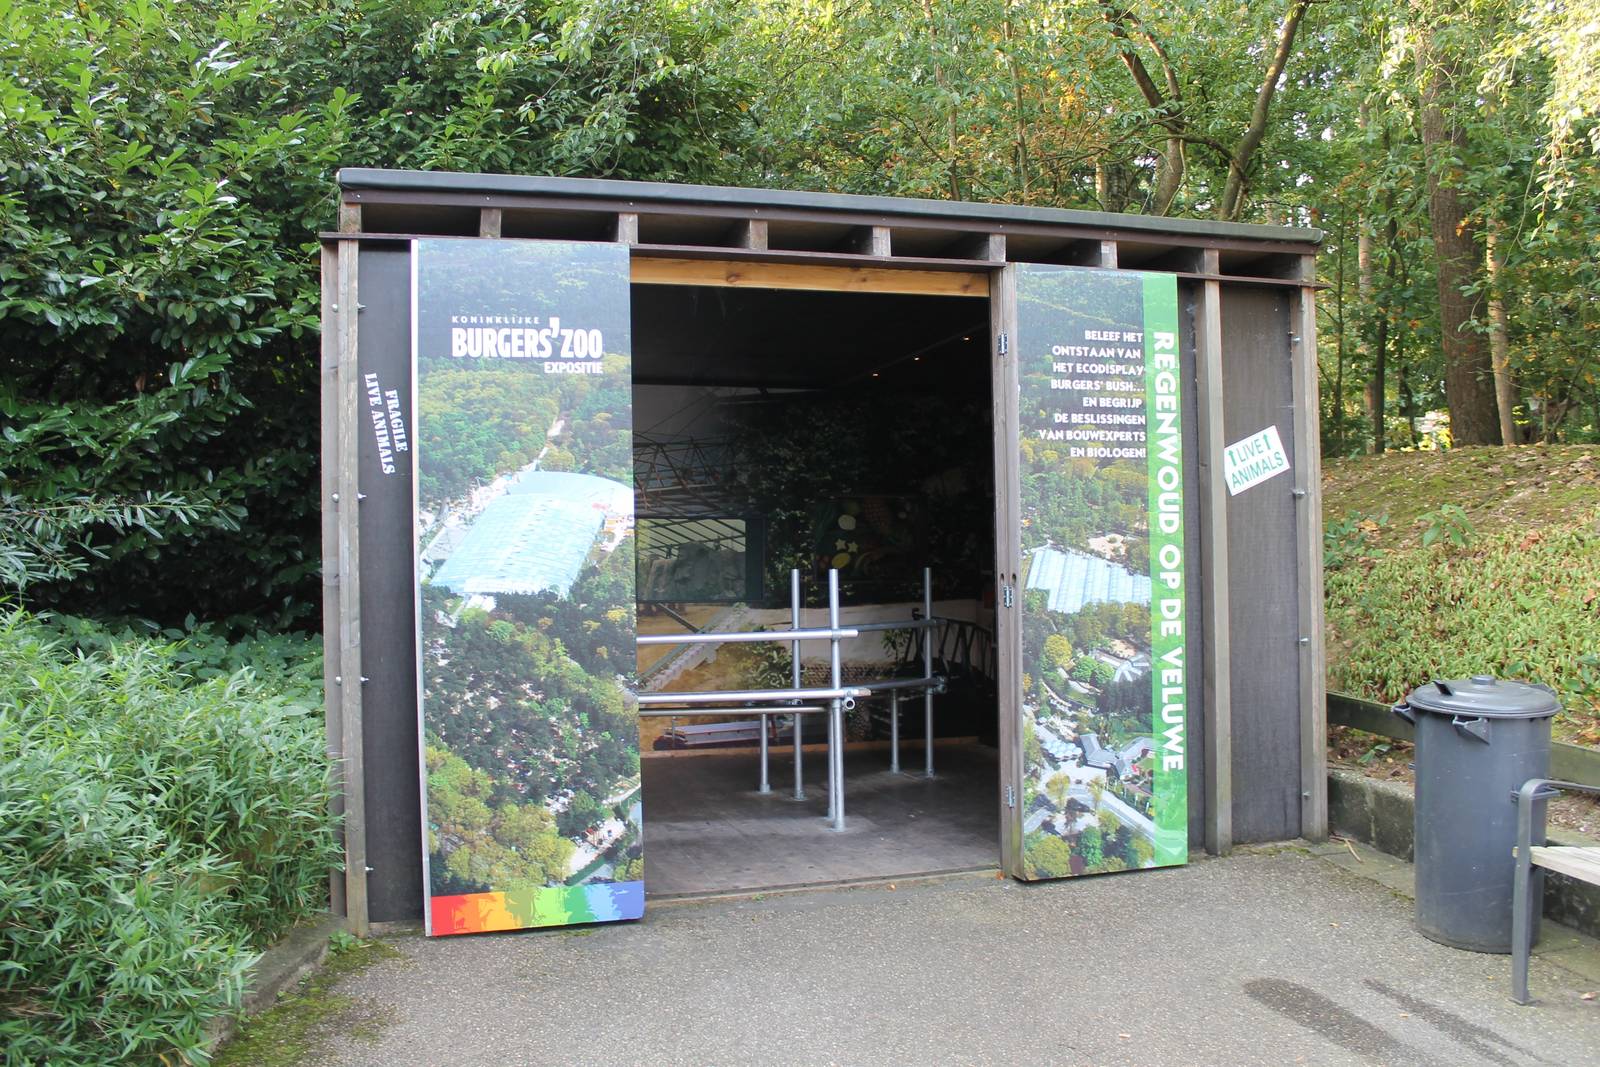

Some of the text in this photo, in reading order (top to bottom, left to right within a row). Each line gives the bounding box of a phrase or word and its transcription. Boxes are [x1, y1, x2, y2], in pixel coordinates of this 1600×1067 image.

[452, 315, 541, 325] KONINKLIJKE
[1084, 330, 1143, 342] BELEEF HET
[1052, 345, 1142, 359] ONTSTAAN VAN
[544, 361, 604, 374] EXPOSITIE
[1053, 362, 1144, 376] HET ECODISPLAY
[1050, 379, 1145, 392] BURGERS' BUSH...
[1082, 397, 1143, 408] EN BEGRIJP
[364, 372, 396, 475] LIVE ANIMALS
[385, 389, 409, 453] FRAGILE
[1054, 413, 1146, 425] DE BESLISSINGEN
[1039, 429, 1146, 442] VAN BOUWEXPERTS
[1070, 447, 1147, 458] EN BIOLOGEN!
[1236, 438, 1264, 463] LIVE
[1231, 451, 1285, 489] ANIMALS
[1152, 331, 1184, 772] REGENWOUD OP DE VELUWE
